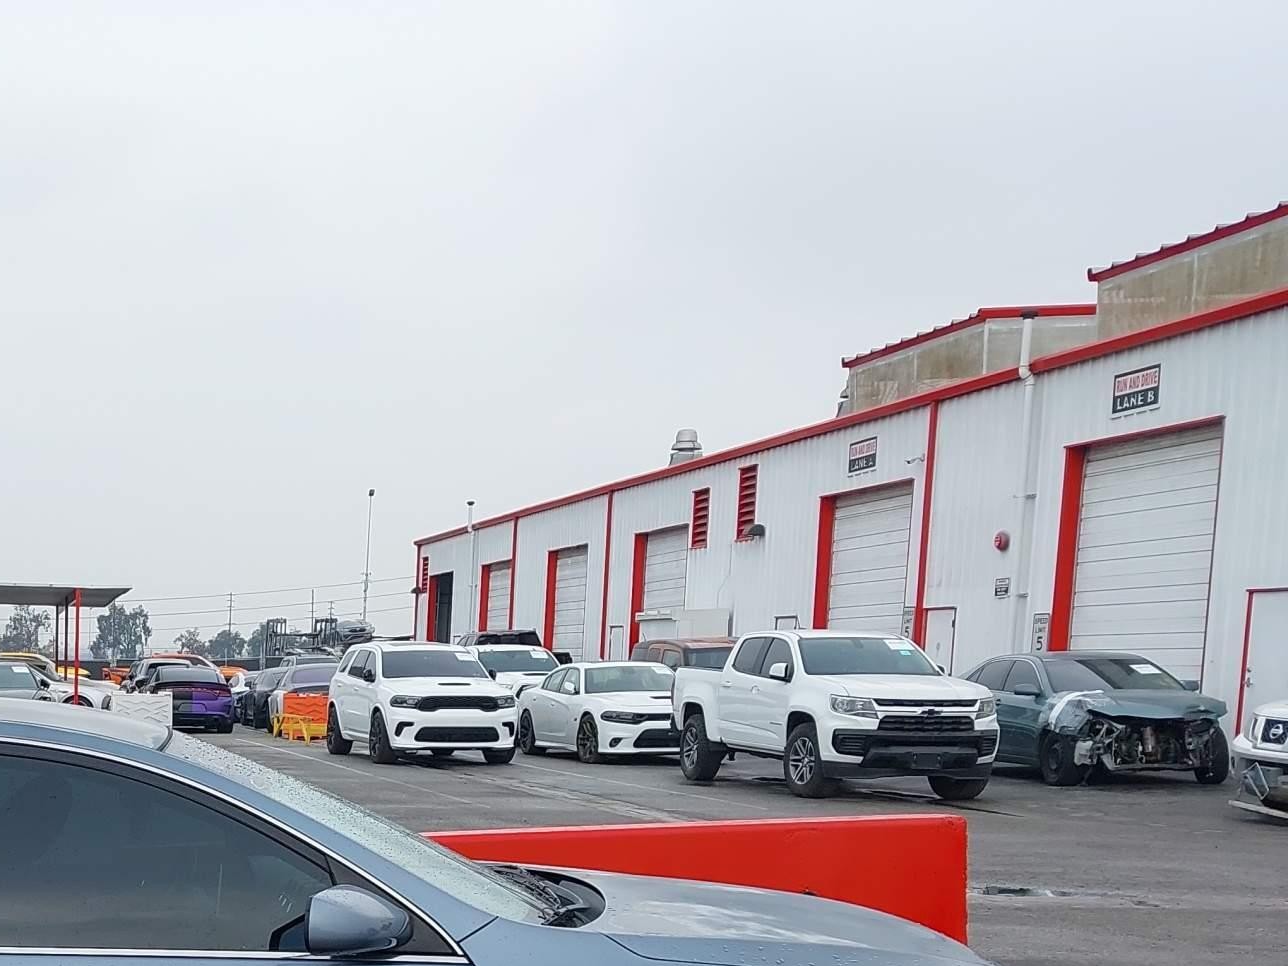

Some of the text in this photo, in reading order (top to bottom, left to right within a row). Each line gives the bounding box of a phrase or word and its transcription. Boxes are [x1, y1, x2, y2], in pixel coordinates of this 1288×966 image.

[1117, 391, 1154, 409] LANE B
[1035, 636, 1043, 651] 5
